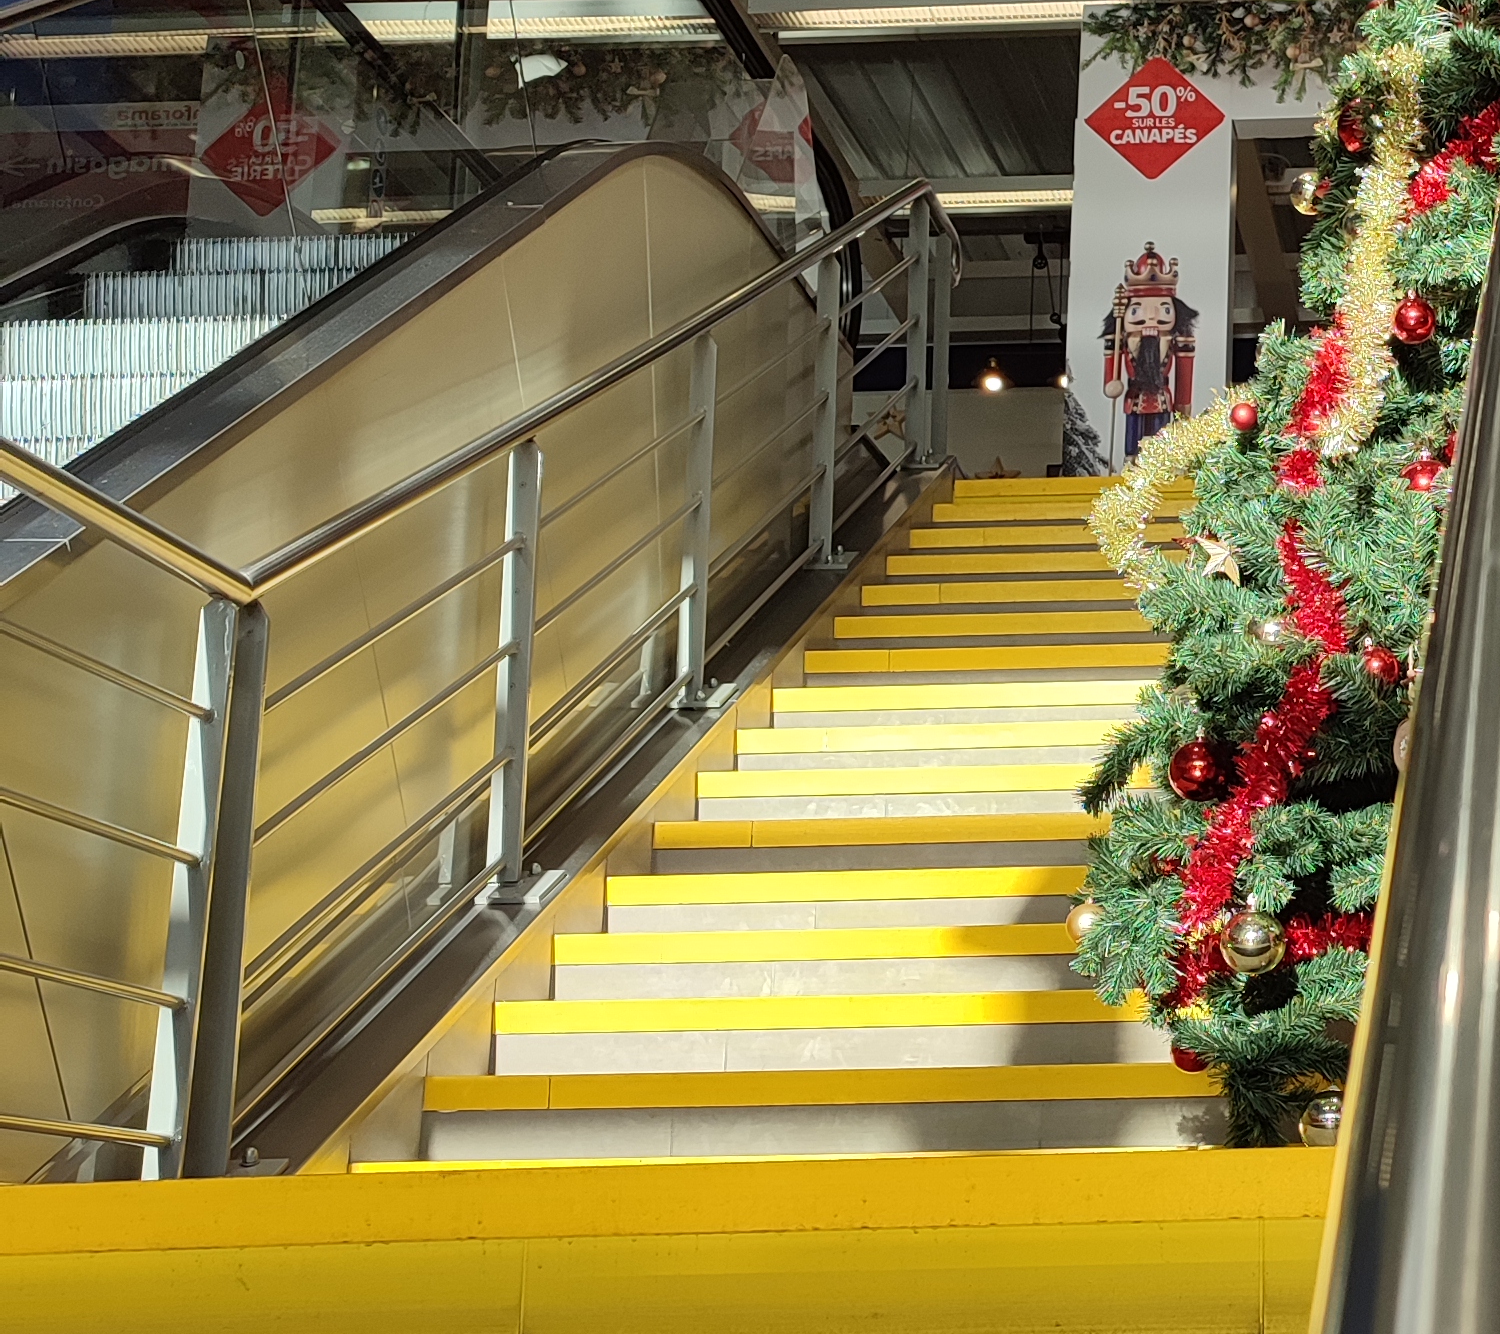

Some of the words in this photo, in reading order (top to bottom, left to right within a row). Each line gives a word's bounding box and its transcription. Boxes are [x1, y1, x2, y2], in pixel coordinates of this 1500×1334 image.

[1113, 85, 1196, 119] -50%
[1131, 117, 1154, 128] SUR
[1155, 117, 1175, 127] LES
[1110, 124, 1197, 145] CANAPÉS
